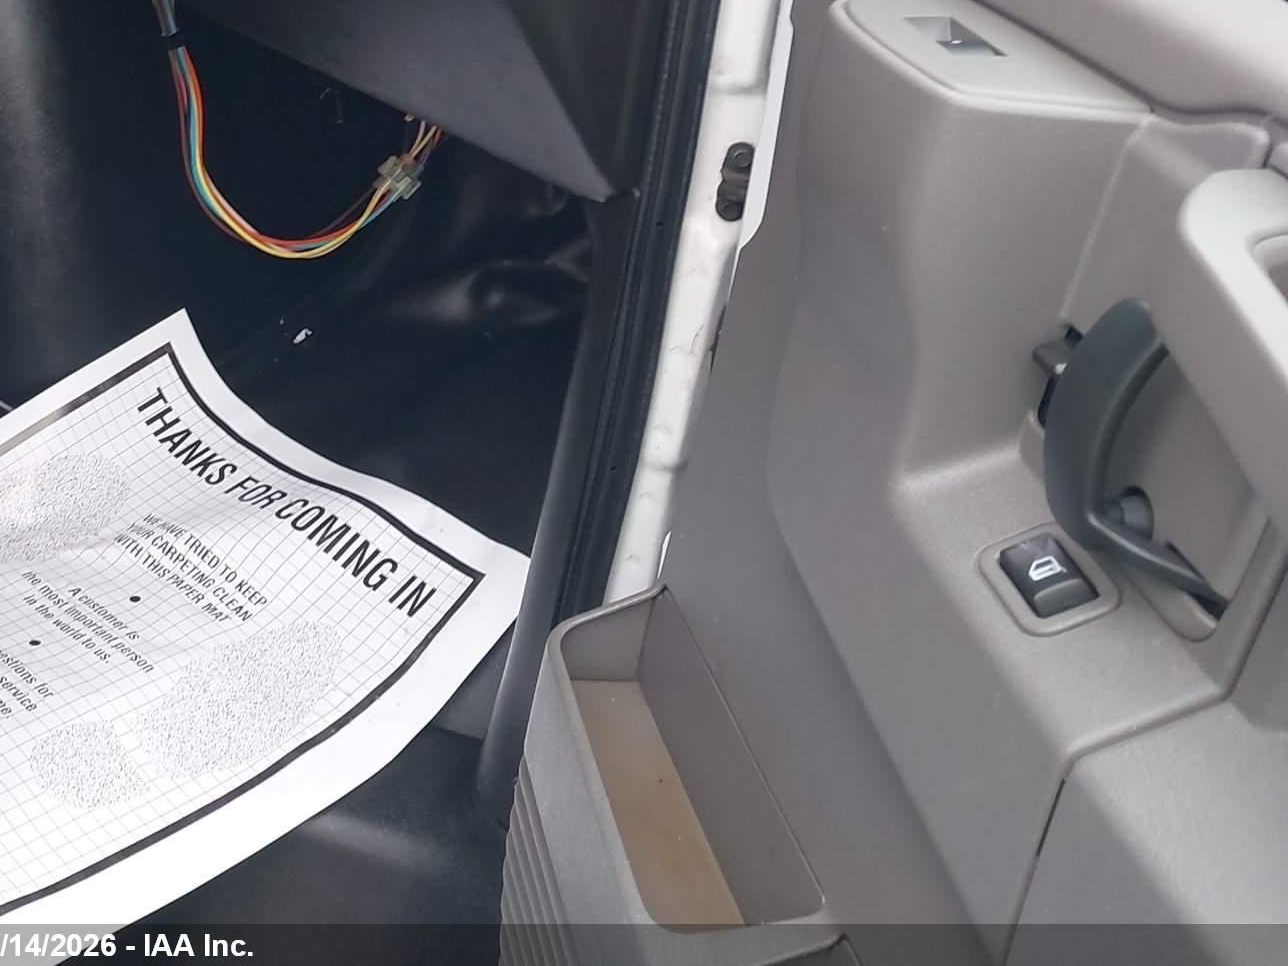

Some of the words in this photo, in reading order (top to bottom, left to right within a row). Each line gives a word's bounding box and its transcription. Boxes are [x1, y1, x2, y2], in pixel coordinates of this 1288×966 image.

[137, 387, 238, 485] THANKS
[224, 475, 288, 510] FOR
[275, 499, 398, 591] COMING
[388, 575, 437, 618] IN
[68, 587, 82, 597] A
[78, 595, 129, 631] customer
[113, 534, 144, 558] WITH
[142, 552, 171, 578] THIS
[166, 573, 205, 605] PAPER
[201, 602, 232, 623] MAT
[151, 535, 216, 589] CARPETING
[212, 586, 253, 622] CLEAN
[184, 534, 220, 569] TRIED
[219, 564, 237, 583] TO
[235, 579, 268, 607] KEEP
[23, 594, 37, 605] in
[35, 604, 54, 619] the
[53, 619, 86, 641] world
[81, 638, 96, 649] to
[93, 648, 111, 664] us.
[38, 585, 69, 609] most
[63, 606, 119, 644] important
[111, 637, 154, 673] person
[34, 683, 54, 698] for
